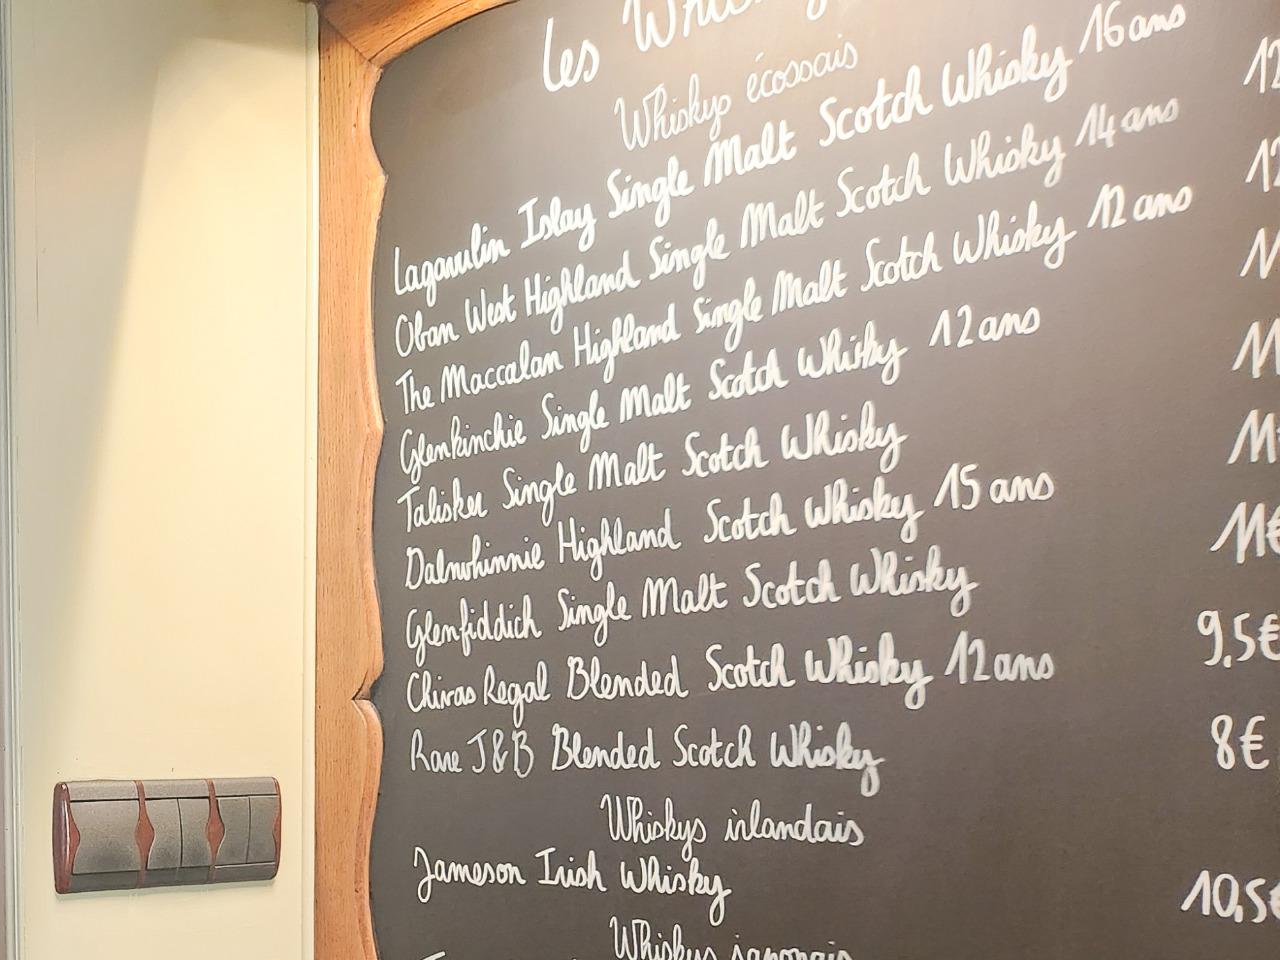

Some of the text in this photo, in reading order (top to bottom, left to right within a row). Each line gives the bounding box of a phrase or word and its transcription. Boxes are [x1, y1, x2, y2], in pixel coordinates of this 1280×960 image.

[746, 34, 858, 103] écossais
[517, 196, 596, 251] Islay
[607, 156, 694, 228] Single
[704, 120, 797, 186] Malt
[819, 65, 932, 147] Scotch
[942, 24, 1073, 107] Whisky
[395, 122, 1066, 358] Oban West Highland Single Malt Scotch Whisky
[395, 200, 1077, 415] The Maccalan Highland Single Malt Scotch Whisky
[399, 320, 908, 485] Glenkinchie Single Malt Scotch Whisky
[396, 400, 908, 534] Talisker Single Malt Scotch Whisky
[557, 507, 682, 582] Highland
[704, 491, 798, 544] Scotch
[804, 476, 925, 544] Whisky
[405, 543, 980, 667] Glenfiddich Single Malt Scotch Whisky
[1196, 609, 1280, 669] 9,5€
[407, 631, 934, 728] Chivas Regal Blended Scotch Whisky
[551, 720, 886, 798] Blended Scotch Whisky
[600, 794, 864, 863] Whiskys irlandais
[413, 847, 732, 926] Jameson Irish Whisky
